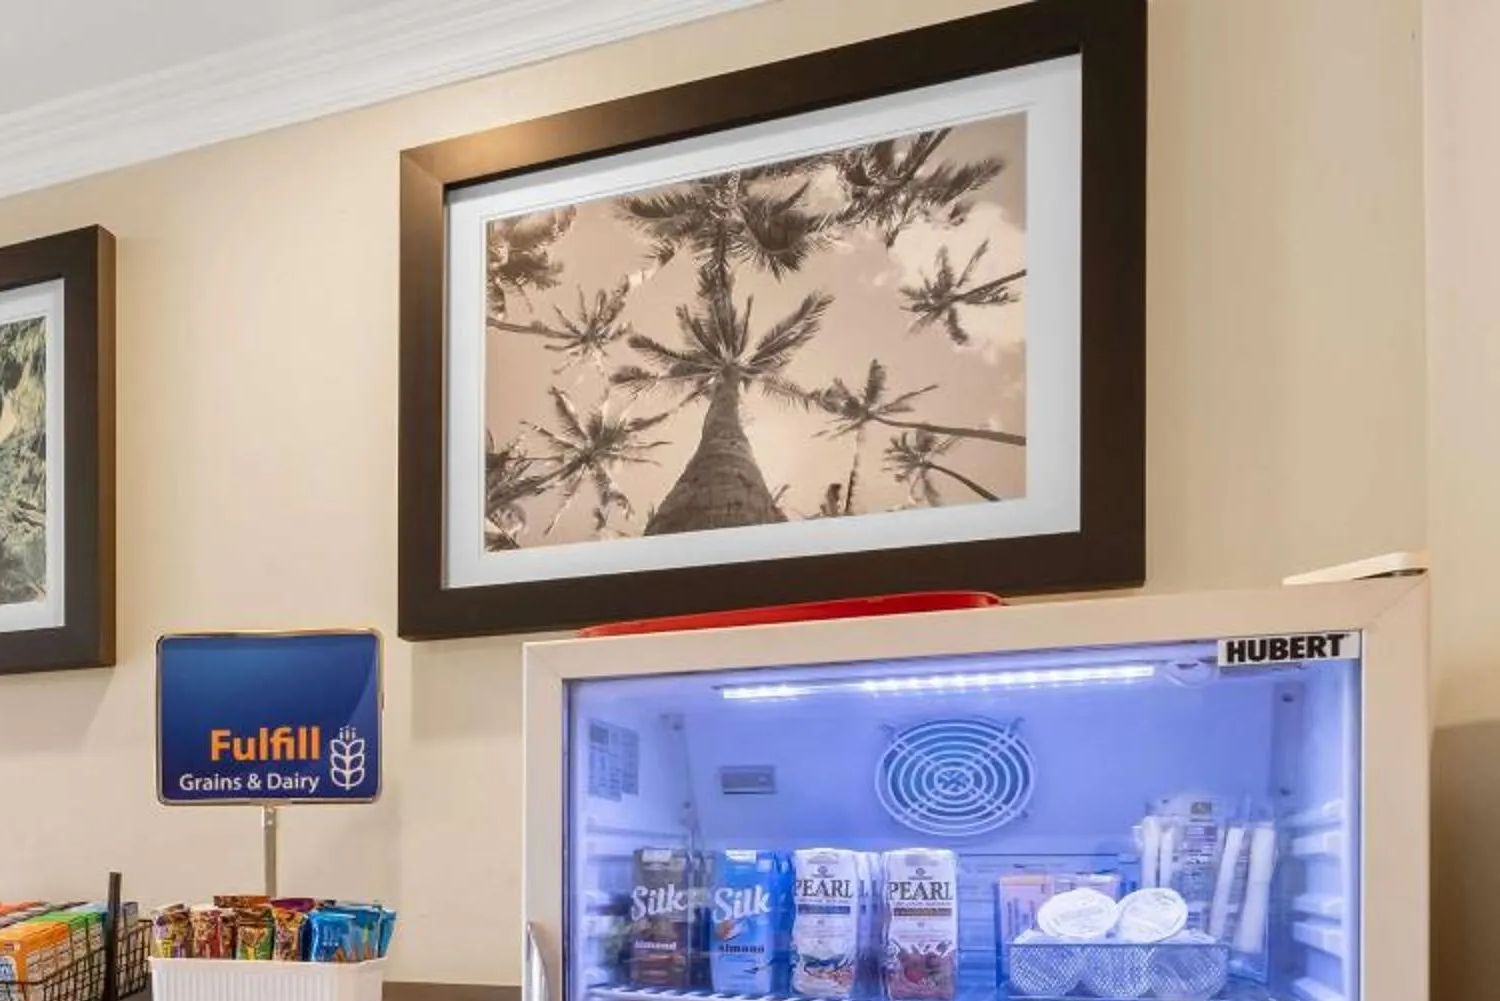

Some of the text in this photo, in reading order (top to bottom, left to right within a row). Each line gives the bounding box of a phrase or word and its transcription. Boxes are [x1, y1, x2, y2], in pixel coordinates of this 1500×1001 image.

[1226, 634, 1345, 663] HUBERT
[210, 726, 321, 761] Fulfill
[179, 772, 321, 794] Grains & Dairy
[631, 883, 688, 921] Silk
[793, 879, 853, 898] PEARL
[887, 882, 954, 901] PEARL
[711, 884, 772, 924] Silk
